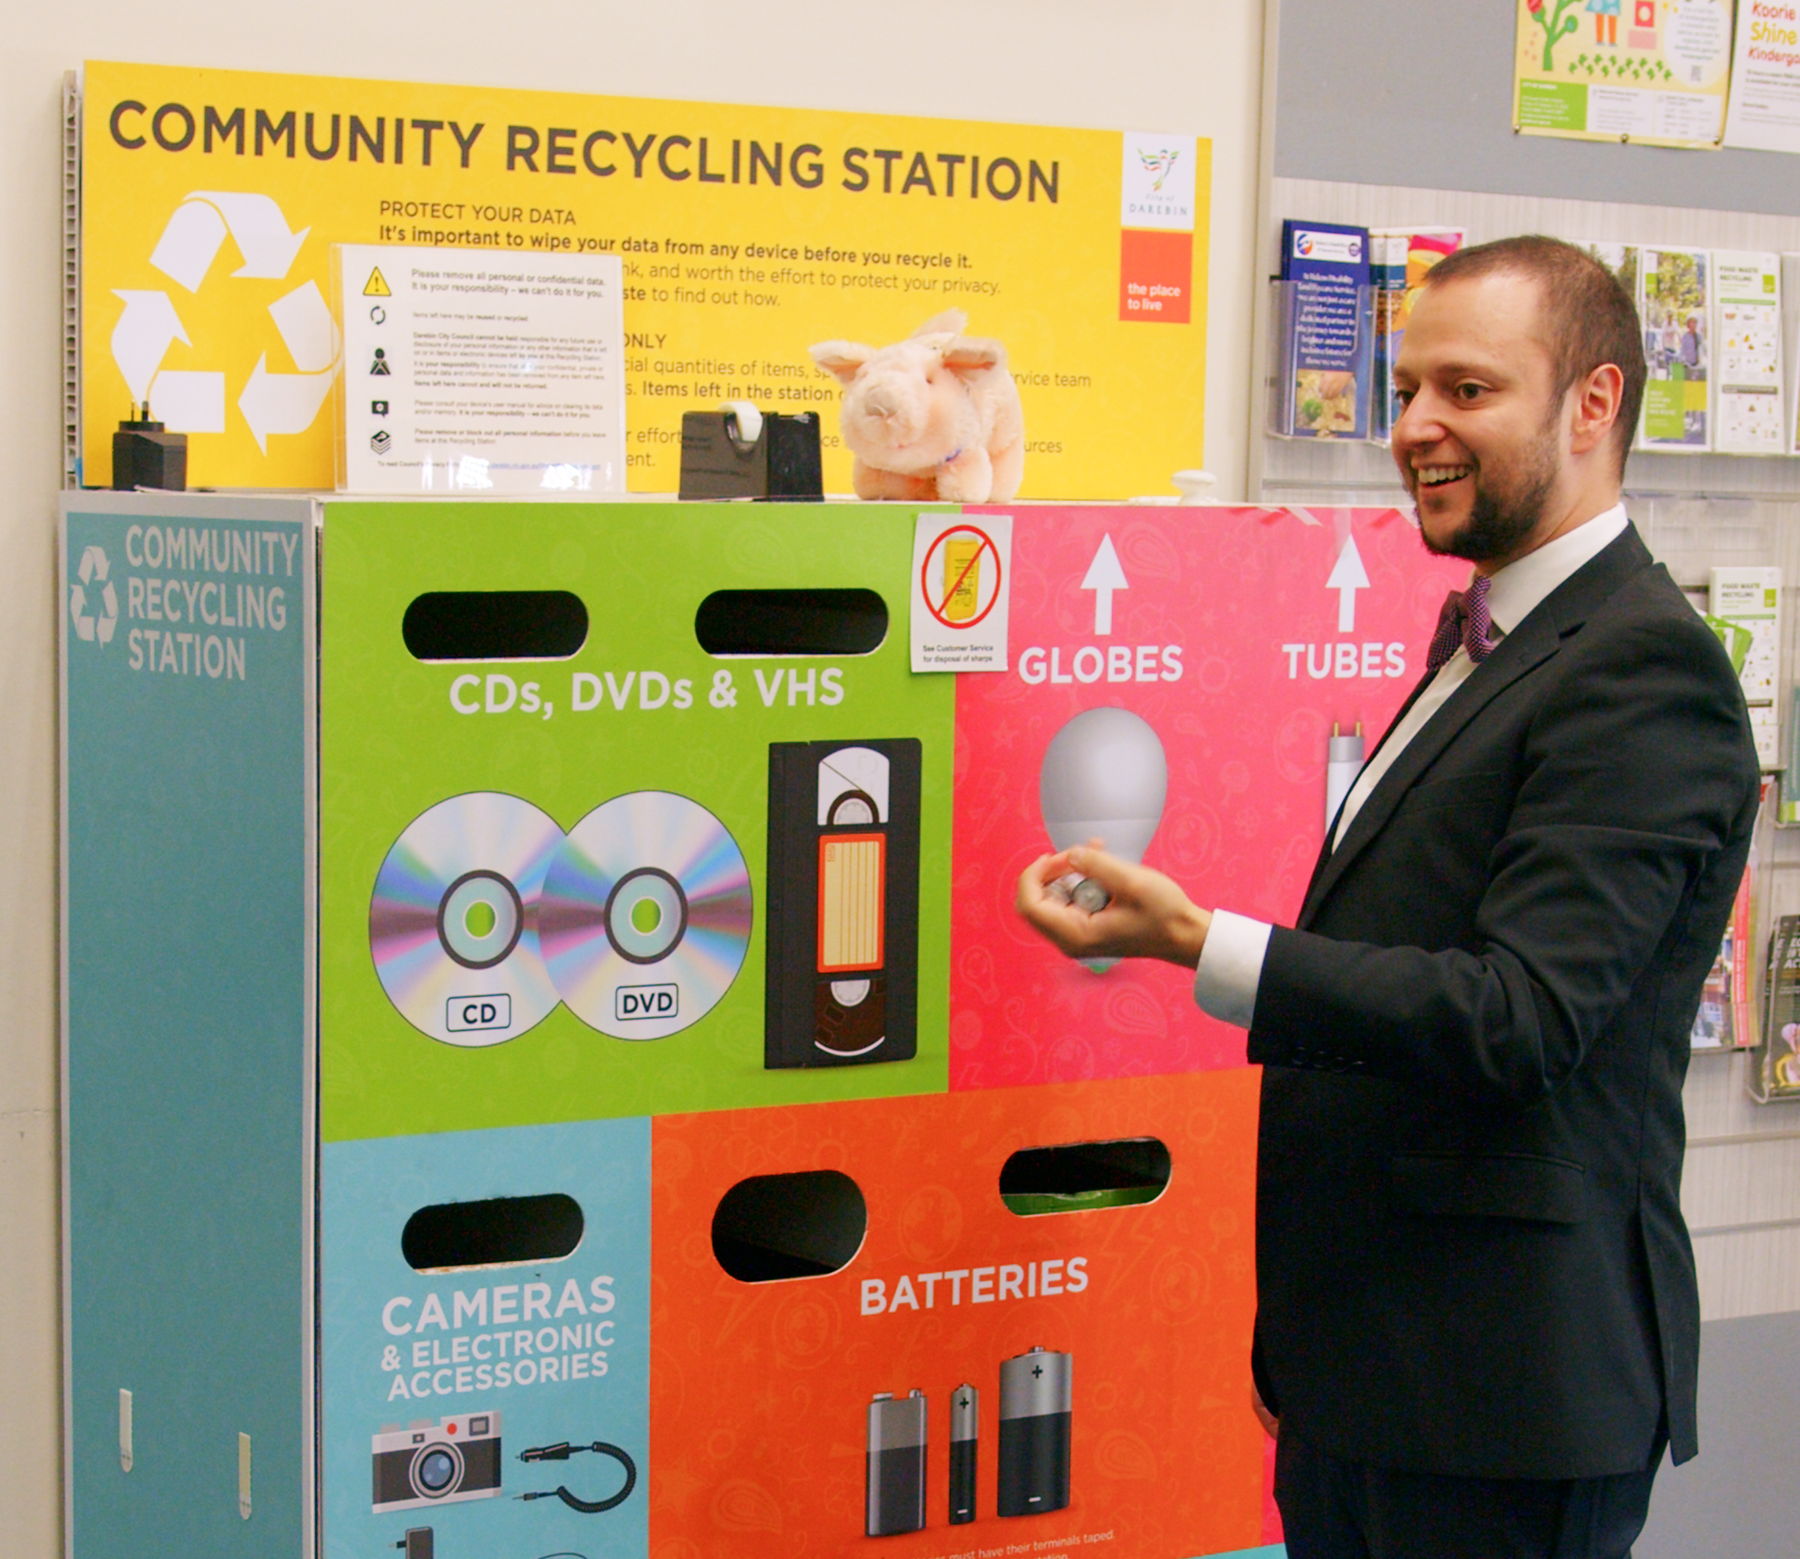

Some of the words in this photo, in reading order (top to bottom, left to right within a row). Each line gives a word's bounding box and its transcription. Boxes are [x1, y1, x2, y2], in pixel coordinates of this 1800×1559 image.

[1752, 0, 1796, 20] Koorie
[1750, 21, 1797, 46] Shine
[109, 100, 485, 168] COMMUNITY
[506, 125, 825, 189] RECYCLING
[842, 147, 1060, 204] STATION
[380, 200, 466, 219] PROTECT
[472, 204, 523, 222] YOUR
[530, 208, 577, 226] DATA
[1129, 203, 1188, 216] DAREBIN
[380, 225, 407, 241] It's
[412, 227, 500, 245] important
[506, 233, 524, 247] to
[530, 233, 572, 252] wipe
[578, 237, 616, 252] your
[621, 237, 659, 253] data
[665, 239, 704, 255] from
[710, 244, 739, 260] any
[745, 243, 798, 260] device
[804, 246, 857, 263] before
[863, 252, 891, 267] you
[897, 252, 952, 270] recycle
[958, 253, 973, 269] it.
[411, 268, 440, 278] Please
[442, 271, 474, 279] remove
[476, 271, 486, 280] all
[488, 272, 524, 283] personal
[537, 274, 584, 285] confidential
[586, 276, 607, 286] data.
[650, 264, 681, 279] and
[686, 265, 734, 283] worth
[739, 267, 766, 283] the
[771, 268, 815, 285] effort
[821, 272, 837, 286] to
[842, 273, 899, 290] protect
[904, 278, 939, 293] your
[943, 277, 1001, 296] privacy.
[1128, 283, 1147, 295] the
[1150, 284, 1181, 297] place
[412, 282, 418, 290] It
[420, 283, 428, 291] is
[430, 284, 449, 293] your
[451, 284, 509, 296] responsibility
[531, 287, 551, 295] can't
[553, 288, 564, 296] do
[566, 288, 572, 296] it
[573, 288, 585, 297] for
[587, 290, 604, 300] you.
[651, 287, 669, 302] to
[674, 286, 706, 304] find
[711, 291, 739, 306] out
[744, 290, 781, 307] how.
[1128, 298, 1140, 310] to
[1142, 298, 1163, 311] live
[654, 359, 736, 376] quantities
[741, 361, 758, 376] of
[762, 362, 810, 380] items,
[1055, 372, 1092, 388] team
[642, 381, 689, 397] Items
[694, 382, 722, 398] left
[727, 384, 741, 399] in
[747, 384, 773, 400] the
[778, 385, 833, 402] station
[126, 524, 298, 579] COMMUNITY
[127, 578, 288, 632] RECYCLING
[127, 636, 247, 682] STATION
[923, 655, 932, 663] for
[934, 655, 961, 664] disposal
[963, 655, 969, 663] of
[936, 644, 968, 652] Customer
[970, 644, 994, 652] Service
[1282, 642, 1406, 680] TUBES
[1018, 644, 1184, 685] GLOBES
[448, 672, 556, 721] CDs,
[570, 670, 693, 713] DVDs
[708, 670, 740, 710] &
[753, 667, 846, 708] VHS
[461, 1000, 497, 1026] CD
[622, 989, 674, 1017] DVD
[859, 1256, 1089, 1317] BATTERIES
[381, 1275, 617, 1338] CAMERAS
[381, 1344, 403, 1373] &
[411, 1320, 616, 1369] ELECTRONIC
[387, 1351, 609, 1402] ACCESSORIES
[978, 1547, 1003, 1558] have
[1005, 1544, 1031, 1556] their
[1033, 1535, 1081, 1551] terminals
